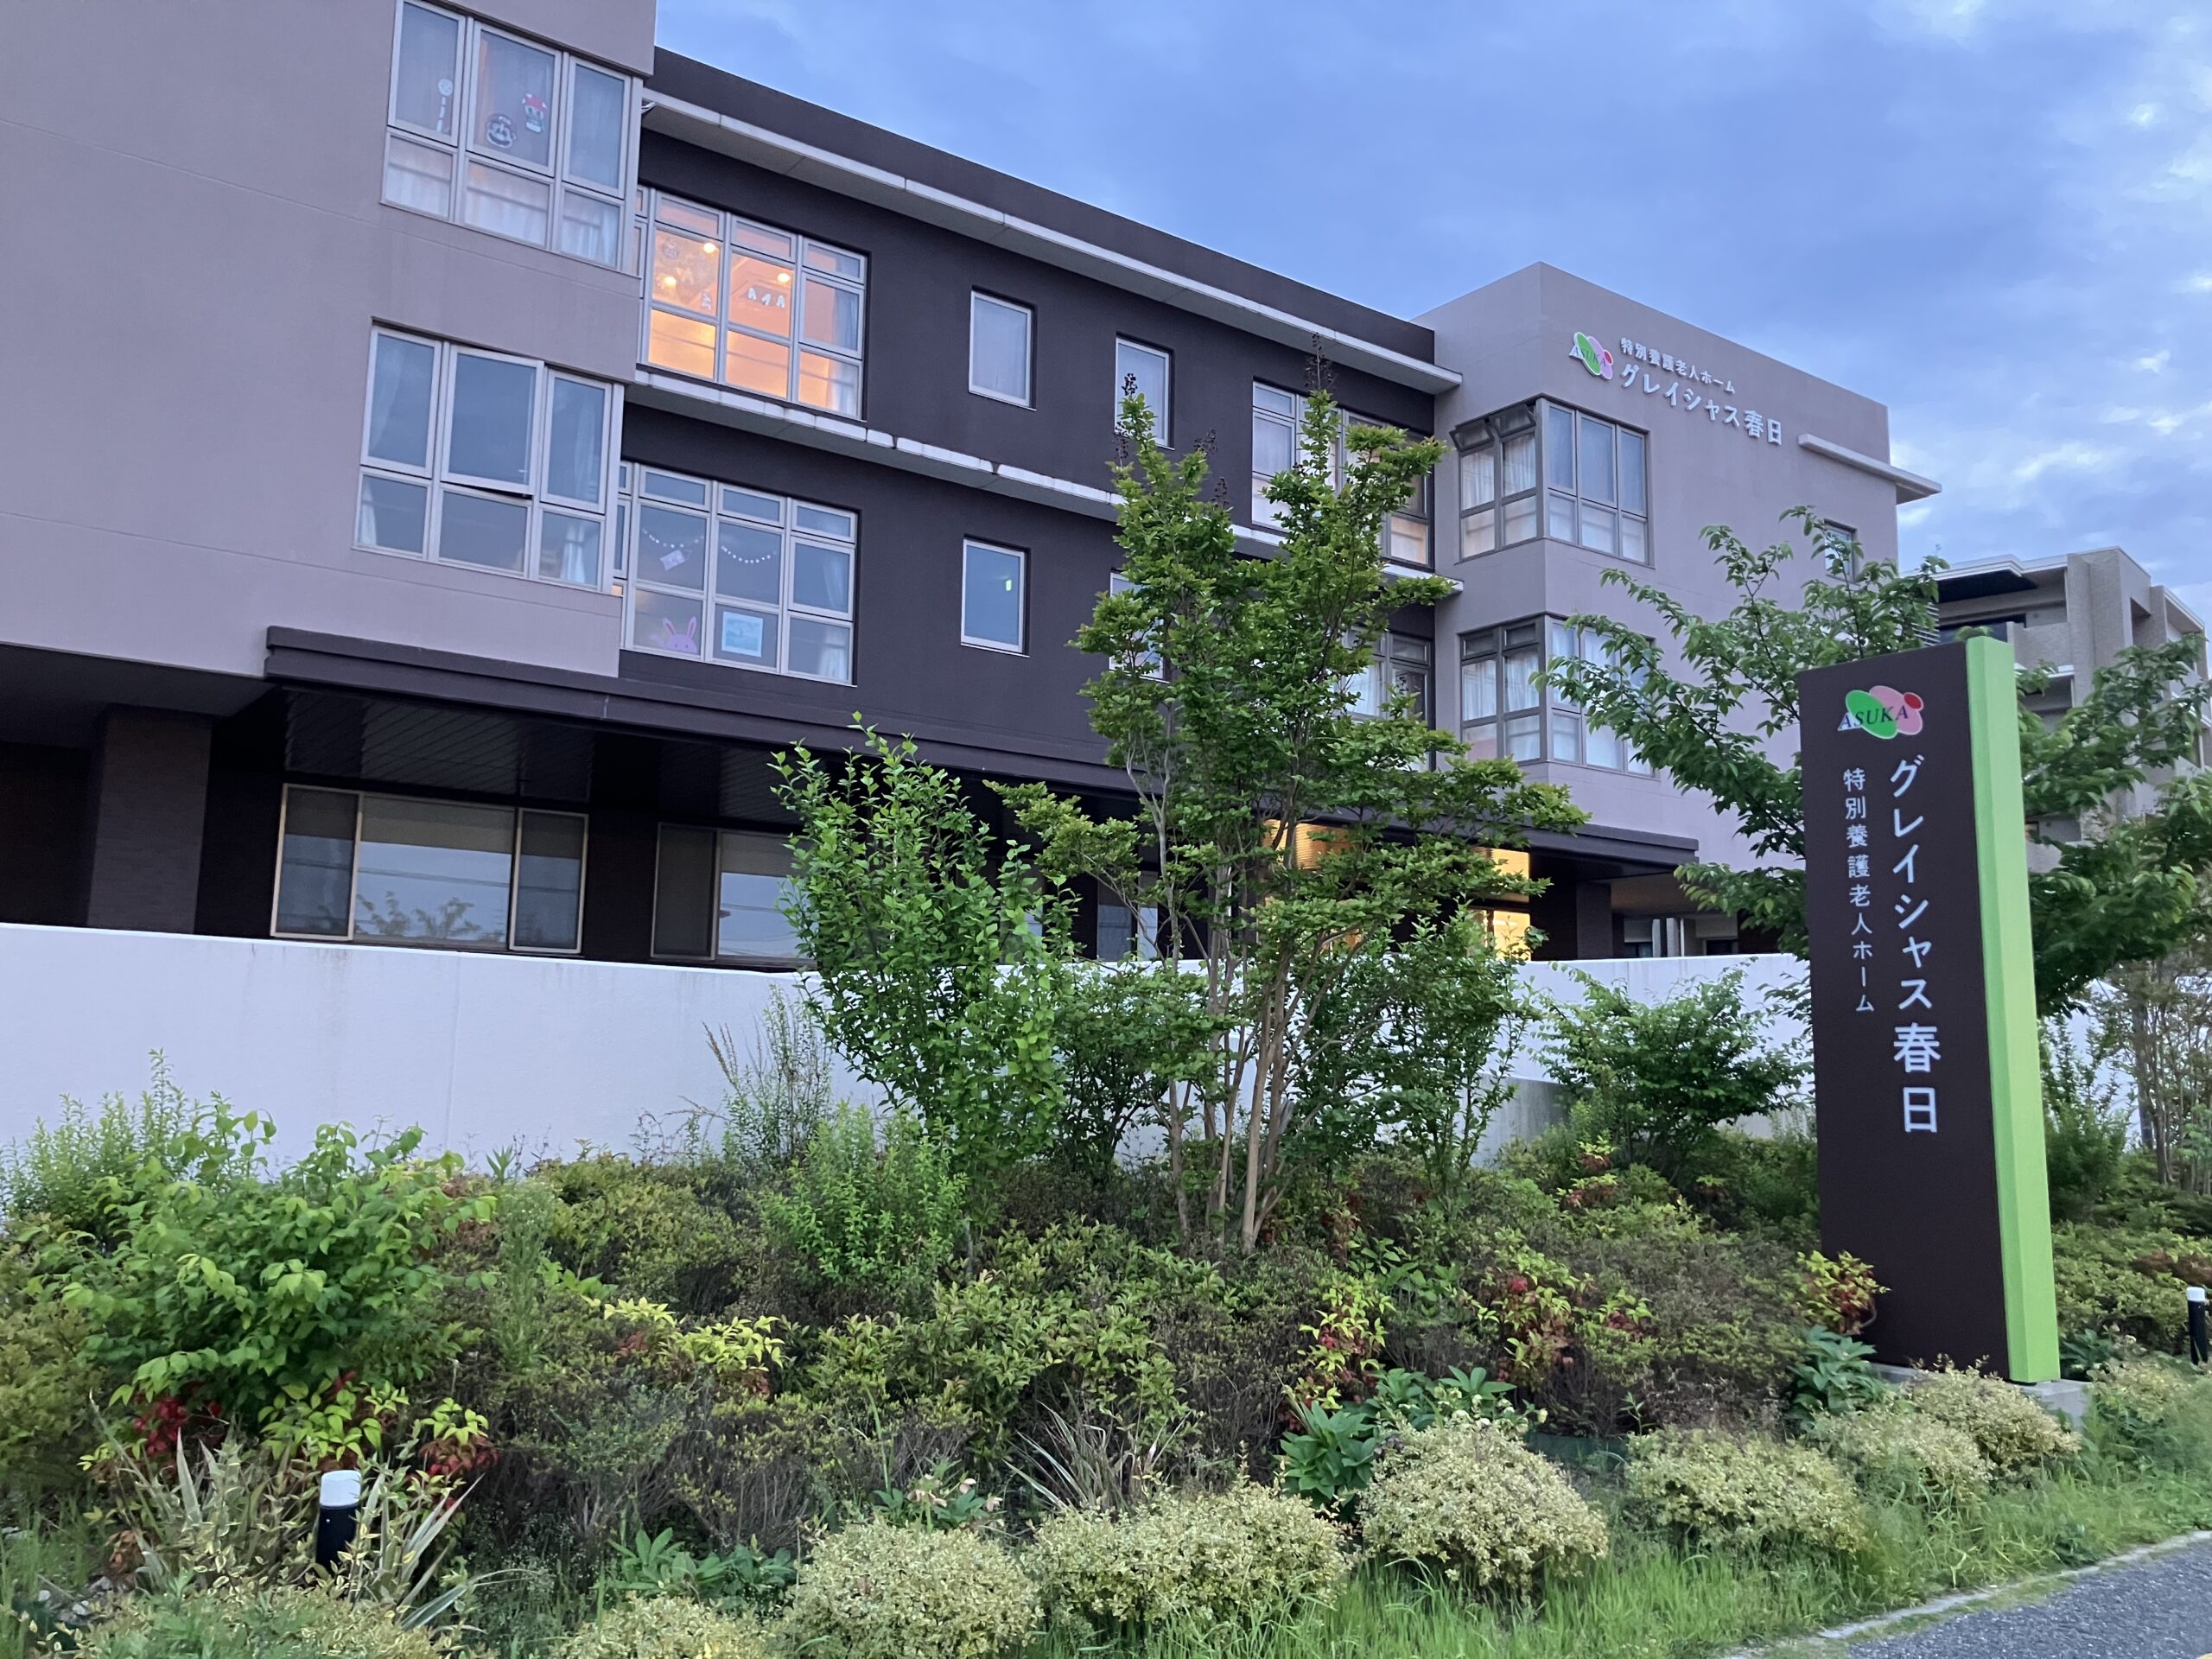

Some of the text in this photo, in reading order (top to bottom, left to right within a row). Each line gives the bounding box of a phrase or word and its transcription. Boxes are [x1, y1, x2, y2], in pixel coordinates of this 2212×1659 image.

[1570, 346, 1607, 367] ASUKA
[1620, 337, 1736, 394] 特別養護老人ホーム
[1620, 363, 1783, 446] グレイシャス春日
[1840, 704, 1909, 729] ASUKA
[1843, 767, 1874, 1013] 特別養護老人ホーム
[1890, 754, 1941, 1133] グレイシャス春日
